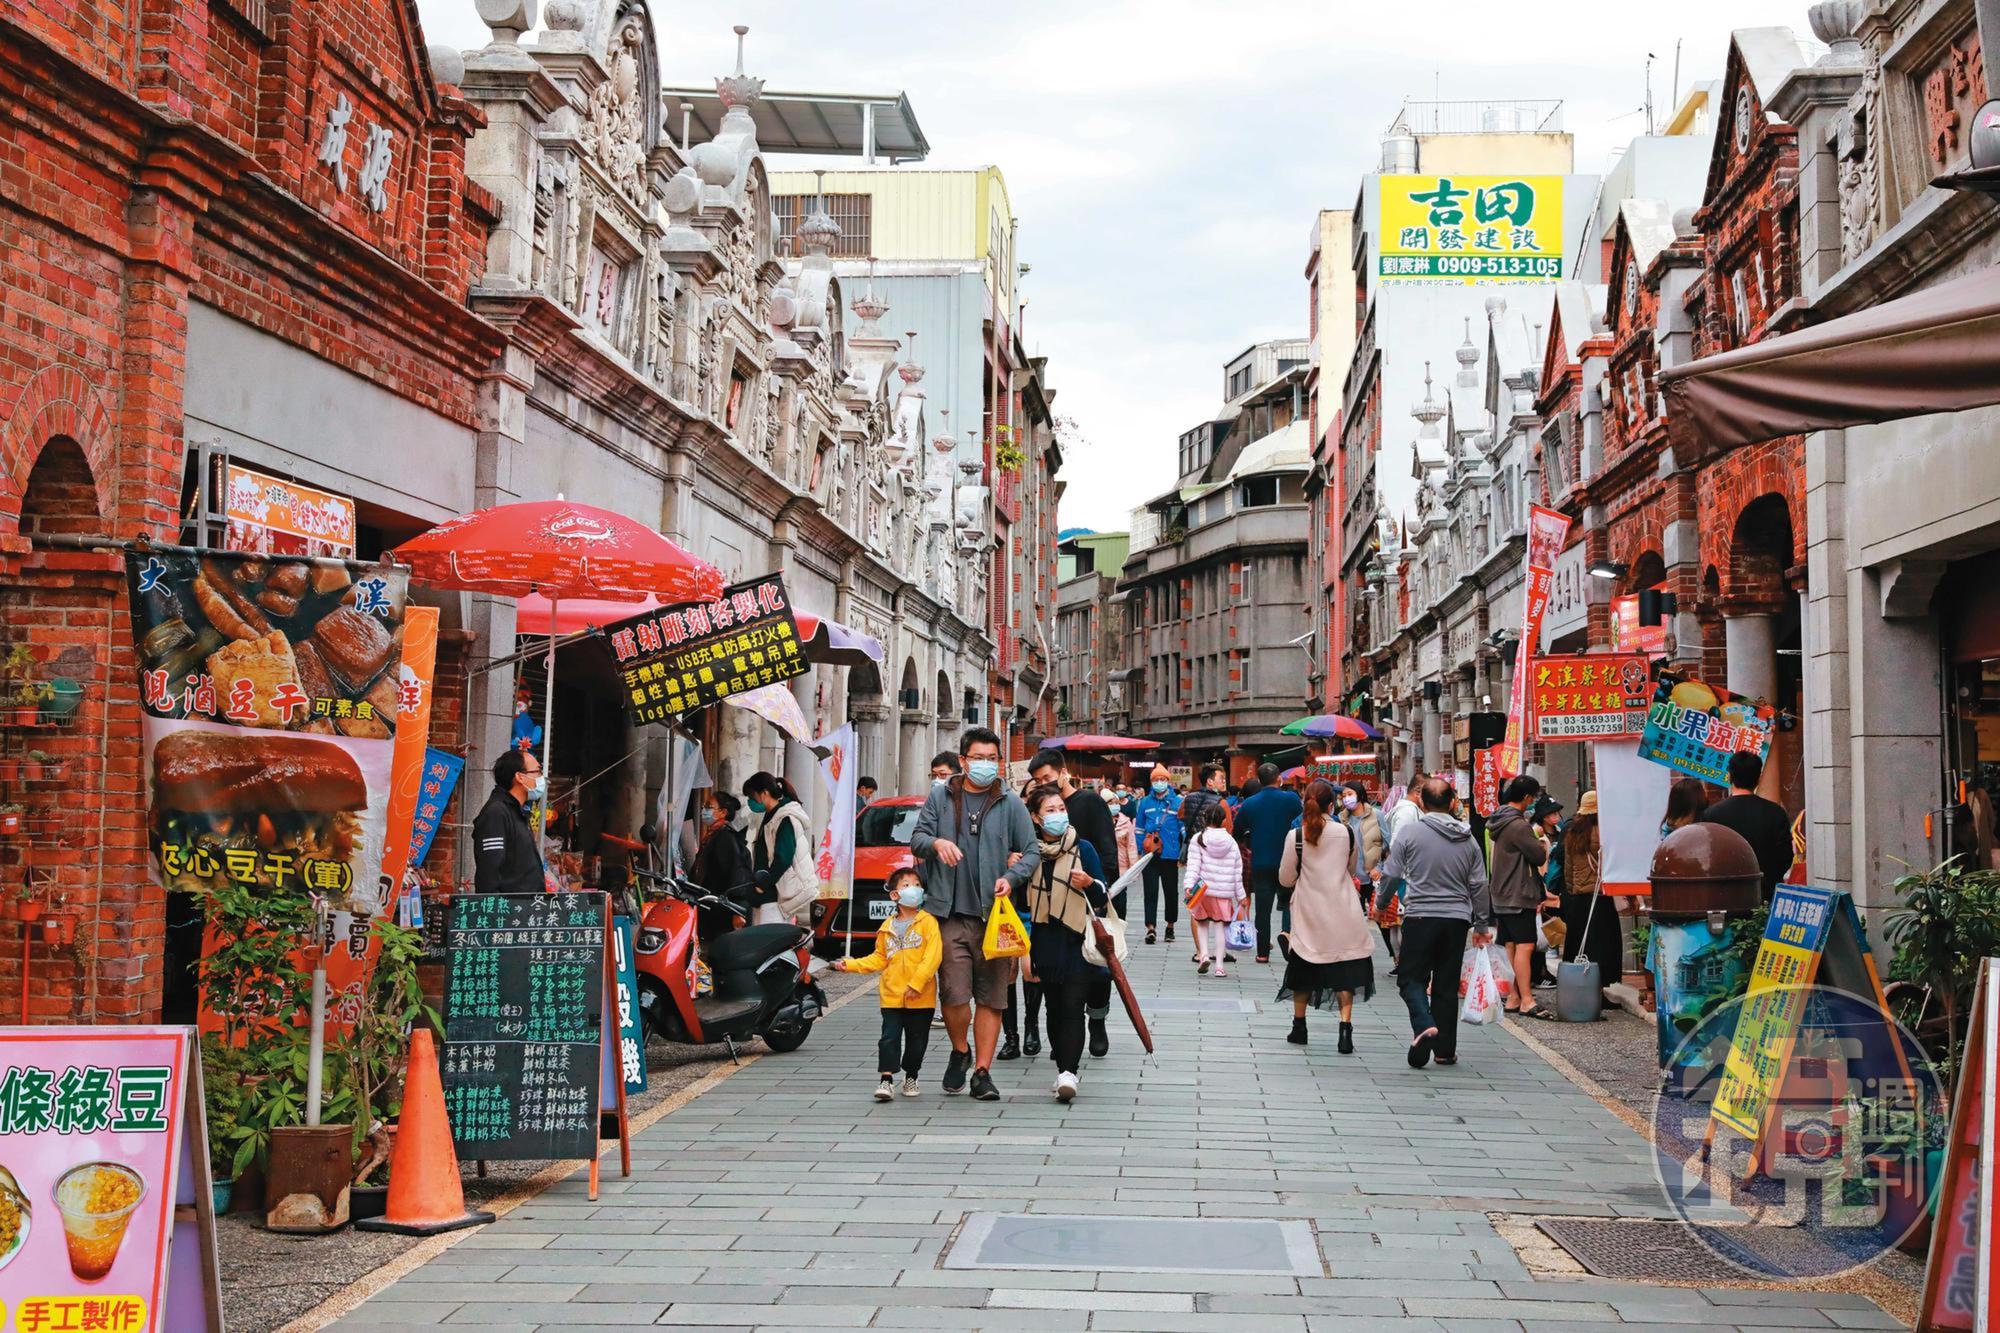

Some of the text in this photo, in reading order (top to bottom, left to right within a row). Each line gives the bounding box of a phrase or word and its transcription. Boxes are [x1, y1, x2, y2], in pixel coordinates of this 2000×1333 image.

[1409, 177, 1535, 228] 吉田
[1400, 227, 1542, 251] 開發建設
[1437, 256, 1559, 275] 0909-513-105
[611, 582, 785, 662] 雷射雕刻客製化
[1537, 664, 1621, 688] 大溪蔡記
[315, 697, 375, 721] 可素食
[1538, 692, 1621, 712] 麥芽花生糖
[1563, 714, 1623, 725] 03-3889399
[1564, 723, 1623, 734] 0935-527359
[1654, 701, 1765, 756] 水果涼糕
[530, 894, 579, 911] 冬瓜茶
[870, 904, 898, 917] AMX-2
[453, 949, 500, 964] 多多綠茶
[530, 948, 596, 960] 現打冰沙
[452, 963, 500, 977] 百香綠茶
[529, 964, 587, 979] 綠豆冰沙
[530, 977, 587, 992] 多多冰沙
[529, 991, 587, 1003] 百香冰沙
[446, 1044, 497, 1058] 木瓜牛奶
[523, 1044, 572, 1057] 鮮奶紅茶
[445, 1059, 496, 1073] 香蕉牛奶
[521, 1071, 570, 1086] 鮮奶冬瓜
[0, 1066, 172, 1134] 條綠豆
[21, 1300, 141, 1333] 手工製作
